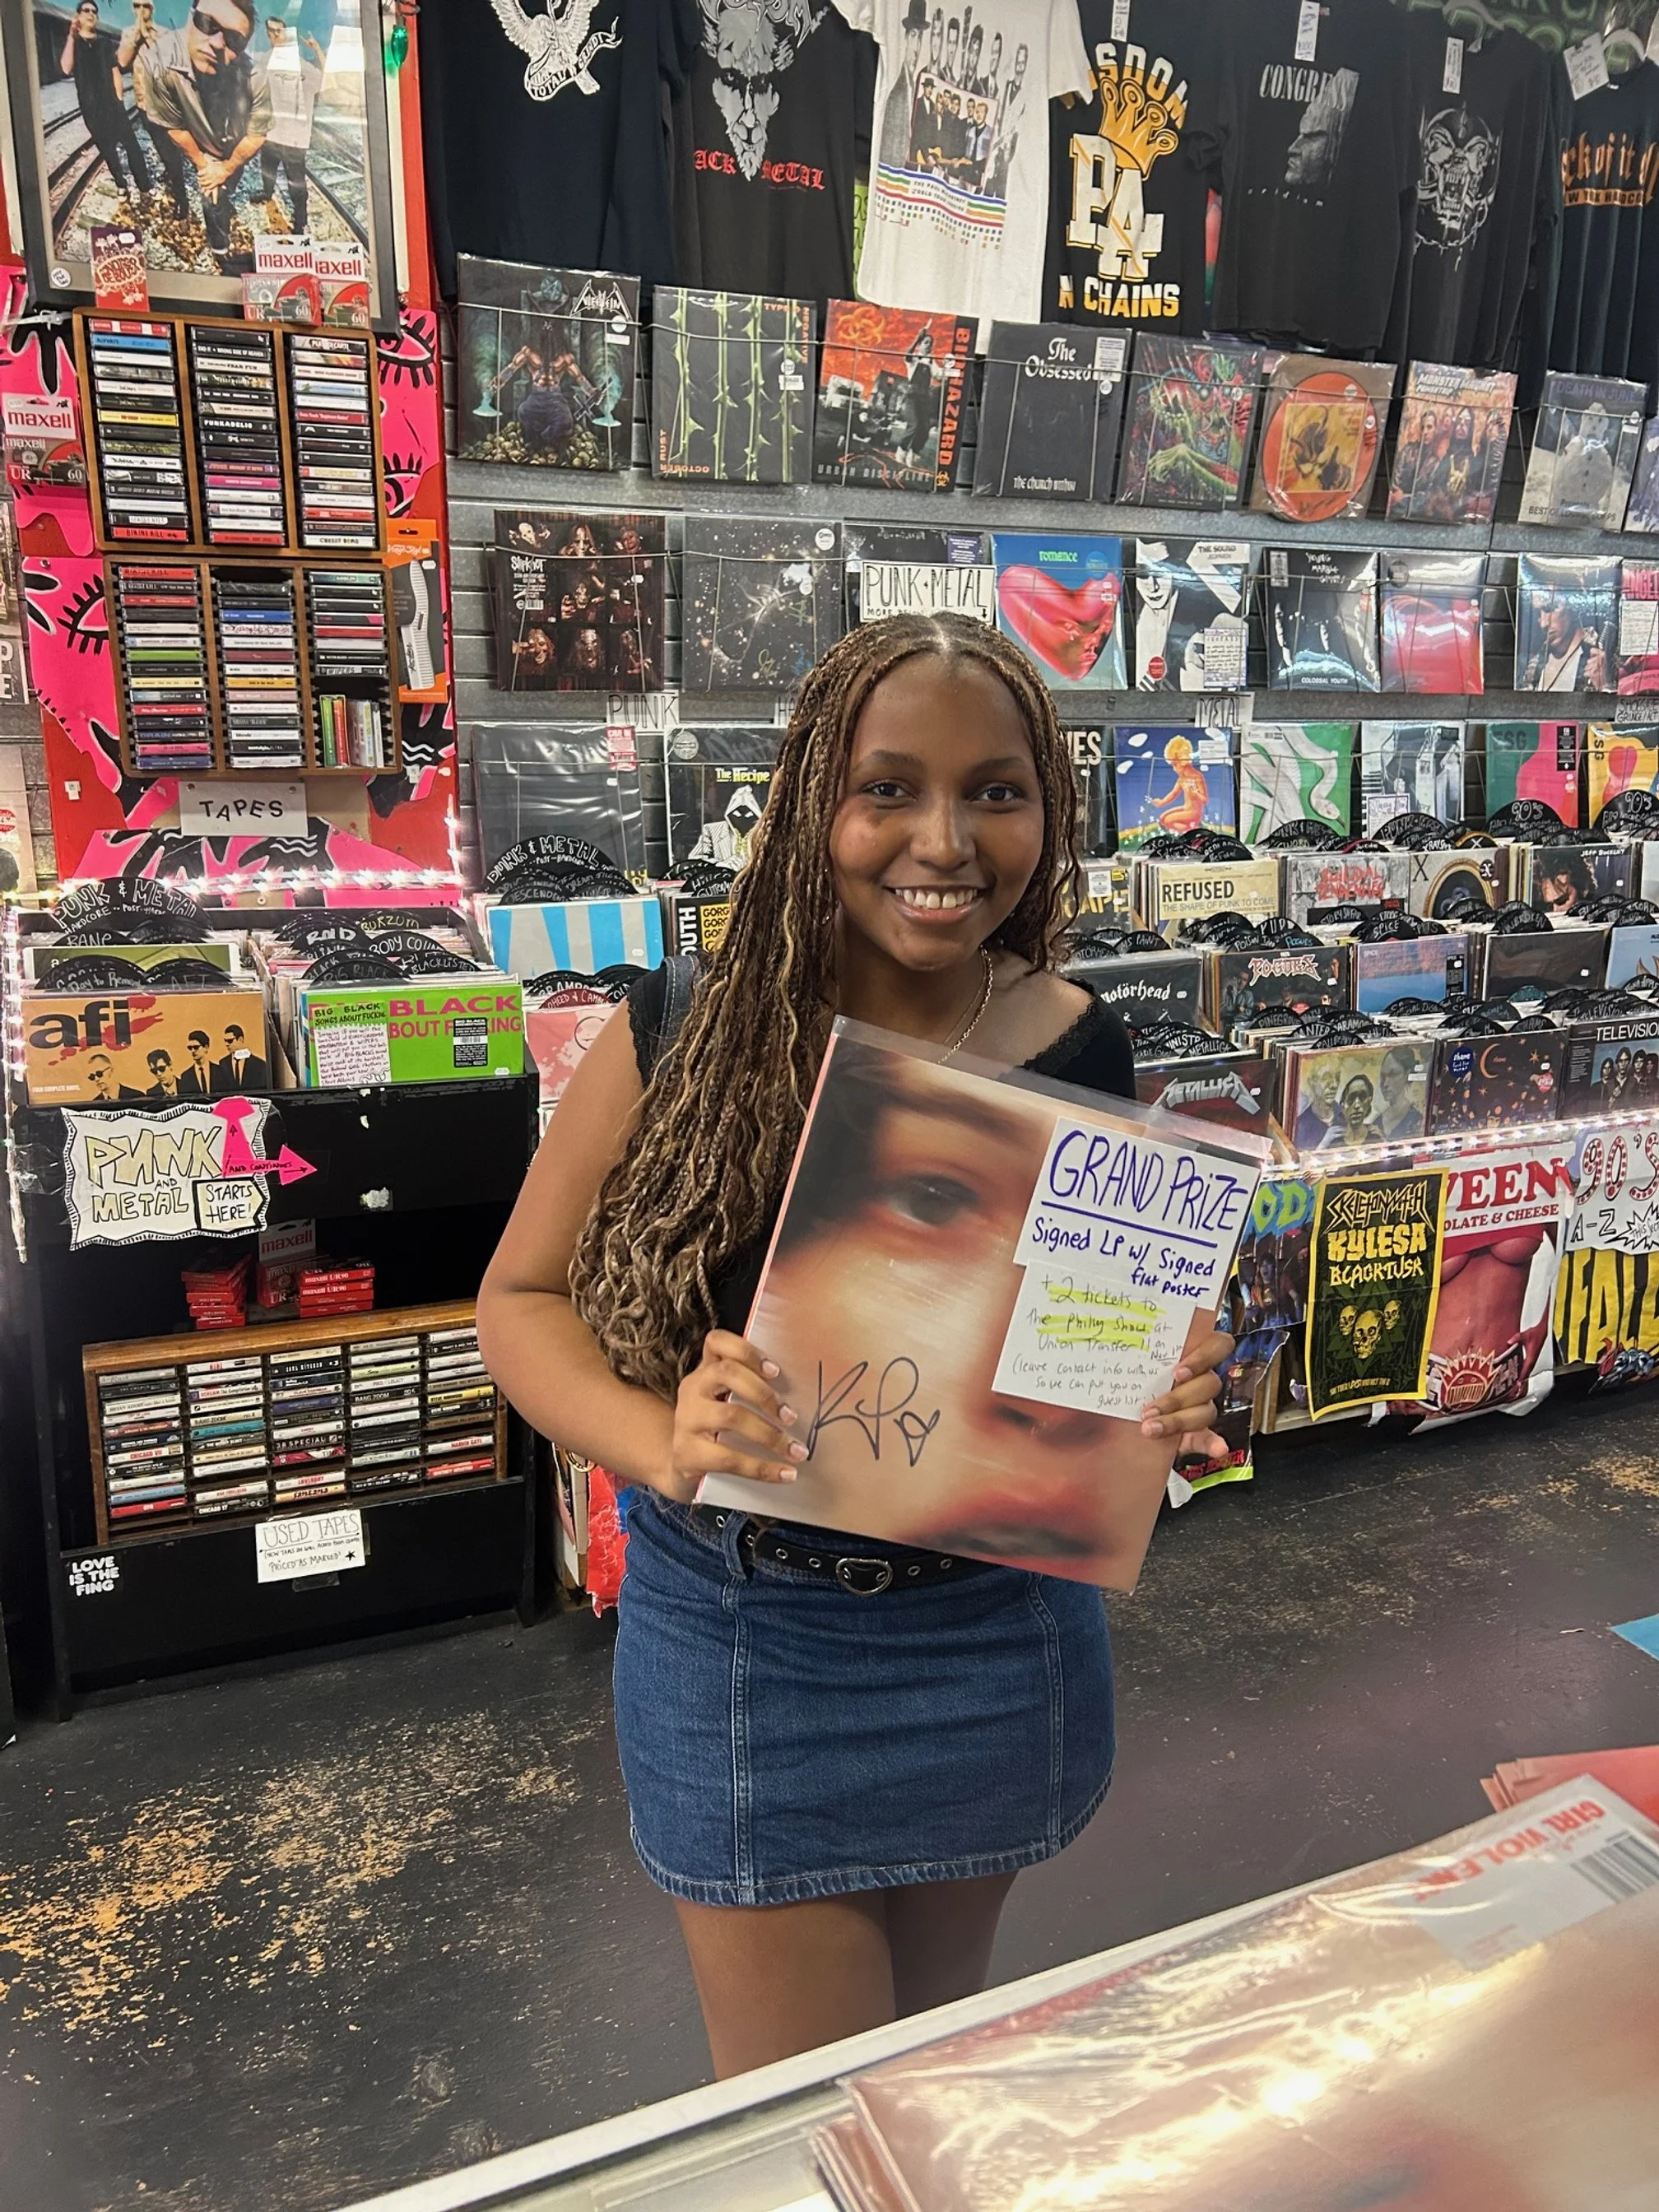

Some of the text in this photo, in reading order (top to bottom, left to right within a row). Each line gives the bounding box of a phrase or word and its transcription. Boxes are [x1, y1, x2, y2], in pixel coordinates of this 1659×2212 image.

[258, 252, 313, 268] maxell
[1084, 282, 1180, 318] CHAINS
[295, 305, 309, 316] 60
[351, 313, 365, 324] 60
[1048, 337, 1076, 362] The
[1025, 355, 1095, 382] Obsessed
[7, 411, 72, 429] maxell
[5, 438, 46, 449] maxell
[10, 467, 83, 480] UR 60
[1039, 550, 1079, 564] romance
[866, 565, 988, 609] PUNK METAL
[1330, 676, 1349, 685] YOUTH
[607, 695, 677, 730] PUNK
[715, 766, 770, 784] The Recipe
[199, 799, 284, 822] TAPES
[540, 834, 601, 867] METAL
[1579, 848, 1597, 857] JEFF
[1412, 854, 1429, 882] X
[1161, 880, 1235, 904] REFUSED
[51, 880, 112, 931] PUNK
[118, 880, 128, 899] &
[1163, 897, 1276, 913] THE SHAPE OF PUNK TO COME
[1372, 921, 1400, 939] SPICE
[1248, 953, 1322, 987] POGUES
[314, 1002, 381, 1018] BIG BLACK
[388, 995, 522, 1018] BLACK
[28, 998, 134, 1051] afi
[315, 1016, 339, 1026] SONGS
[339, 1012, 362, 1023] ABOUT
[1152, 1071, 1261, 1114] METALLICA
[84, 1126, 224, 1189] PUNK
[155, 1178, 179, 1192] AND
[1048, 1129, 1249, 1232] GRAND PRIZE
[206, 1183, 253, 1203] STARTS
[91, 1187, 190, 1224] METAL
[1491, 1211, 1503, 1224] &
[1505, 1203, 1559, 1222] CHEESE
[205, 1206, 253, 1224] HERE!
[1570, 1208, 1617, 1243] A-Z
[260, 1229, 314, 1254] maxell
[1032, 1216, 1215, 1280] Signed LP w/ Signed
[1327, 1221, 1428, 1263] KYLESA
[304, 1275, 328, 1284] maxell
[302, 1287, 326, 1295] maxell
[1057, 1276, 1076, 1304] 2
[1082, 1284, 1132, 1308] tickets
[1141, 1294, 1157, 1313] to
[1154, 1323, 1173, 1334] at
[1038, 1333, 1075, 1351] Union
[1056, 1362, 1097, 1375] contact
[1103, 1363, 1123, 1376] info
[1148, 1368, 1159, 1376] us
[1088, 1380, 1104, 1396] put
[1110, 1382, 1127, 1395] you
[1097, 1396, 1123, 1410] guest
[288, 1436, 325, 1448] SPECIAL
[130, 1452, 154, 1460] CHICAGO
[199, 1506, 221, 1514] CHICAGO
[263, 1513, 360, 1547] USED TAPES
[72, 1555, 115, 1573] LOVE
[69, 1566, 120, 1587] IS THE
[76, 1579, 114, 1596] FING
[1540, 1801, 1606, 1835] GIRL
